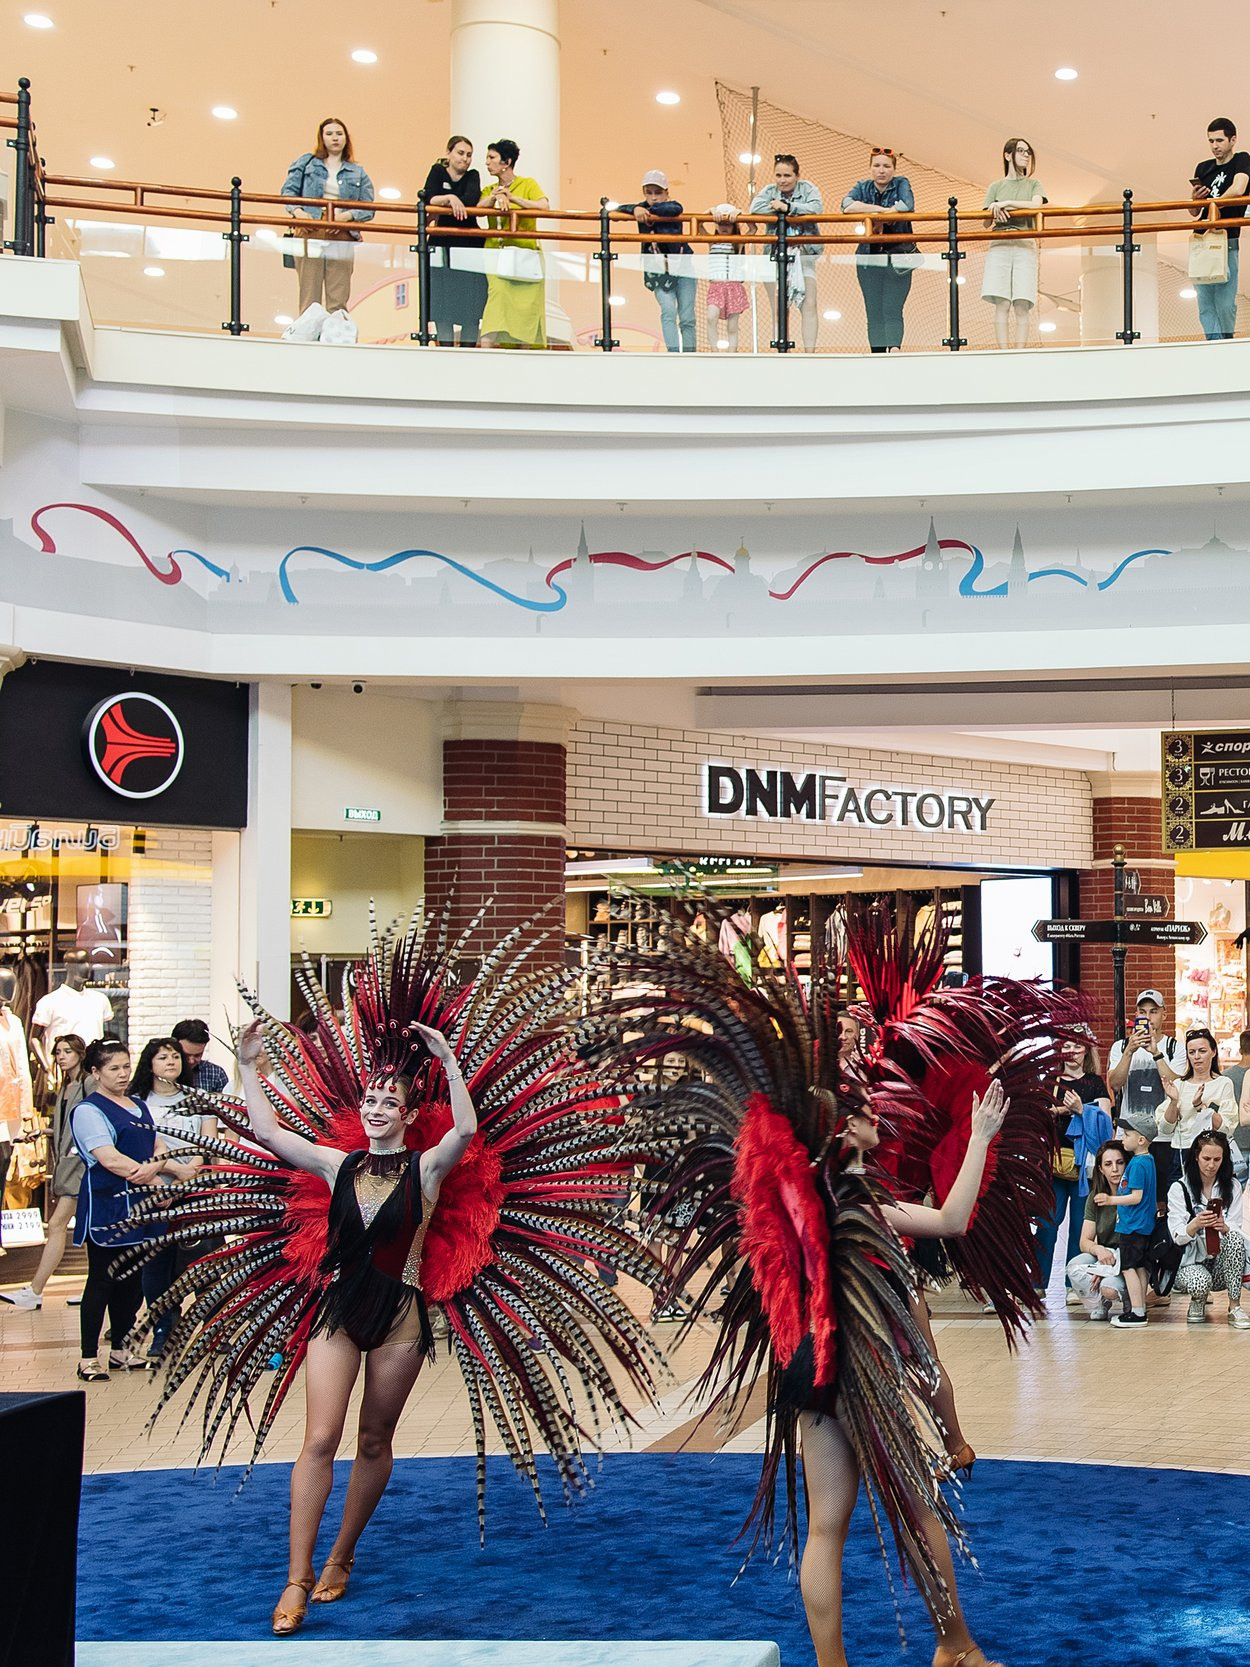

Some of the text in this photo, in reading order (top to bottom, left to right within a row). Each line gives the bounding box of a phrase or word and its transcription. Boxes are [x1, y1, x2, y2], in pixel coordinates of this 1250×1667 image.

[1174, 739, 1183, 753] 3
[1174, 768, 1183, 782] 3
[1175, 796, 1184, 810] 2
[347, 808, 379, 821] ВЫХОД
[1175, 825, 1184, 839] 2
